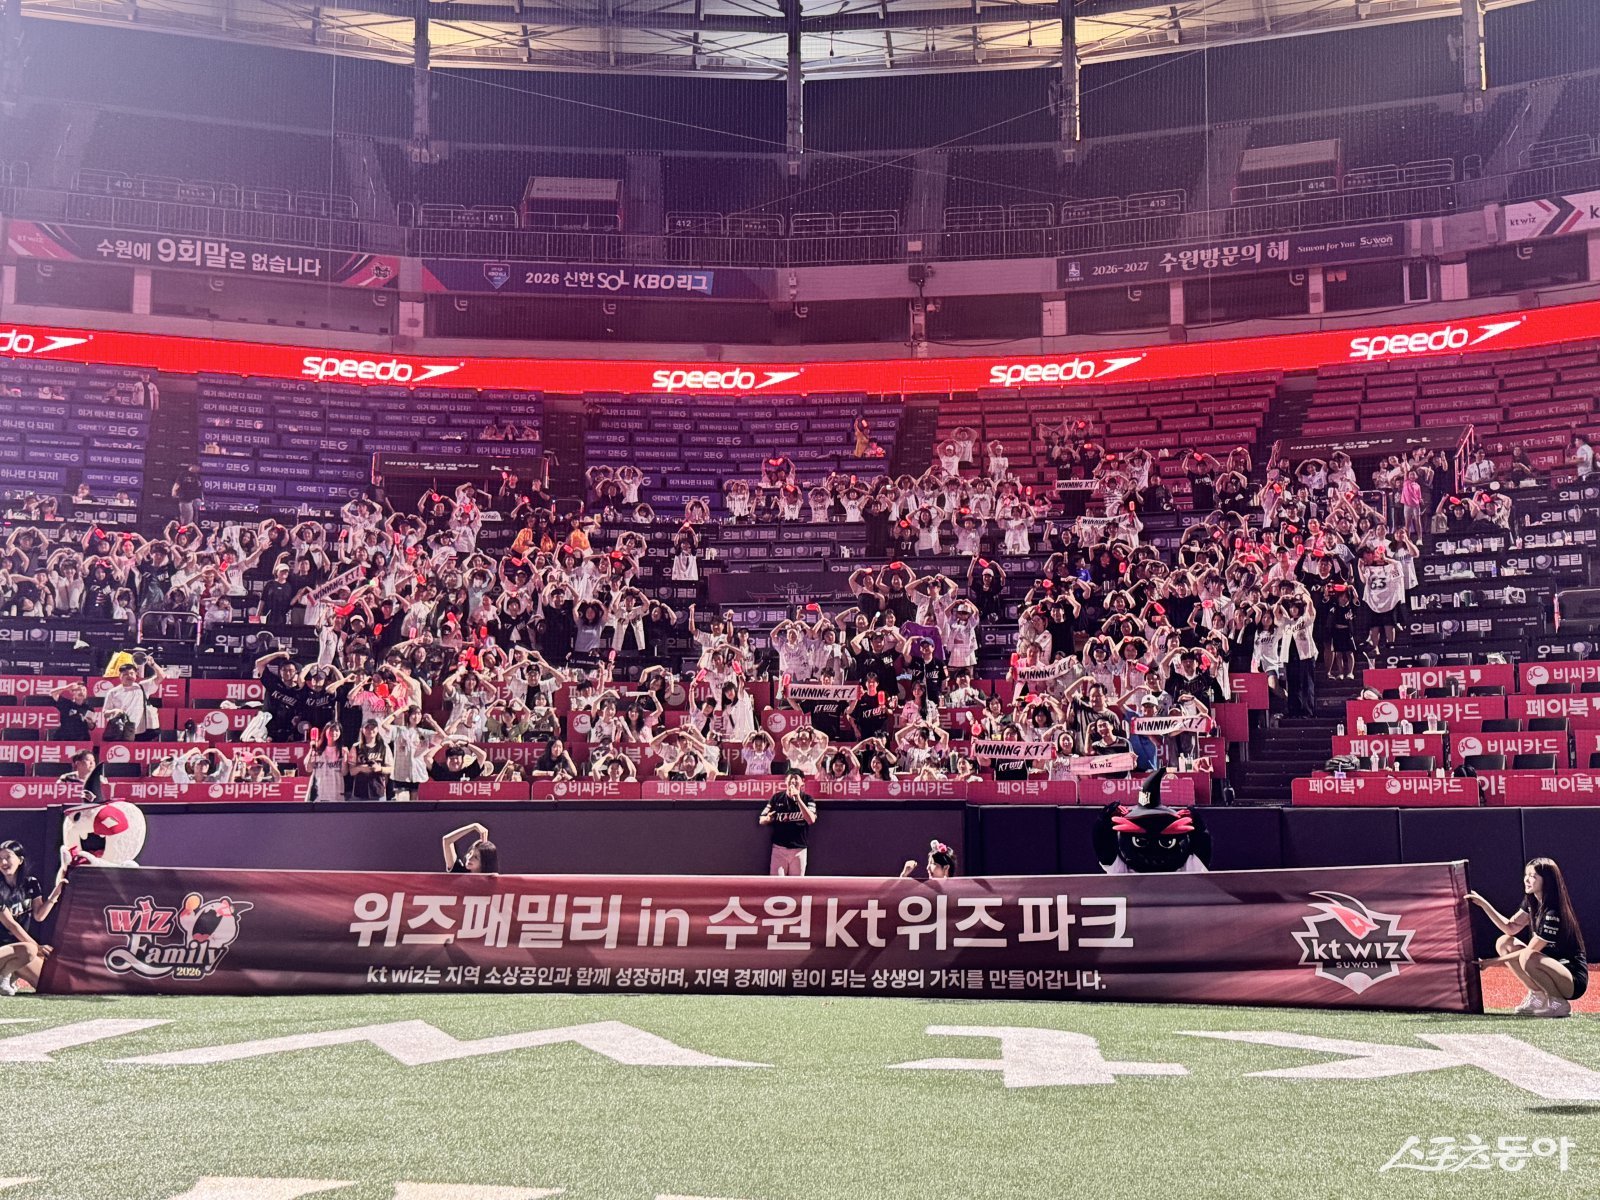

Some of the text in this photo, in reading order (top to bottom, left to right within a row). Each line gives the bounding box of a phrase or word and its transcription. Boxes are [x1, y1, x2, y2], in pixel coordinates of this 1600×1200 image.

[675, 219, 692, 227] 412
[97, 238, 322, 277] 수원에 9회말은 없습니다
[1092, 261, 1150, 276] 2026-2027
[1159, 242, 1262, 273] 수원방문의
[1267, 239, 1289, 261] 해
[525, 272, 559, 285] 2026
[563, 271, 595, 288] 신한
[1350, 326, 1469, 361] speedo
[302, 356, 412, 381] speedo
[990, 358, 1095, 388] speedo
[652, 366, 755, 393] speedo
[1057, 481, 1083, 489] WINNING
[1019, 669, 1056, 680] WINNING
[790, 686, 855, 699] WINNING KT!
[1404, 701, 1483, 722] 비씨카드
[1526, 698, 1590, 718] 페이북
[0, 711, 59, 729] 비씨카드
[1136, 719, 1177, 732] WINNING
[0, 745, 61, 763] 페이북
[975, 743, 1049, 756] WINNING KT!
[1487, 737, 1560, 755] 비씨카드
[135, 745, 185, 765] 비씨카
[1089, 758, 1112, 770] kt wiz
[27, 783, 84, 799] 비씨카드
[131, 783, 179, 799] 페이북
[224, 783, 281, 799] 비씨카드
[449, 782, 492, 797] 페이북
[568, 782, 620, 797] 비씨카드
[657, 782, 698, 797] 페이북
[819, 781, 862, 797] 페이북
[903, 781, 954, 797] 비씨카드
[997, 781, 1039, 797] 페이북
[1308, 778, 1355, 795] 페이북
[1402, 777, 1464, 795] 비씨카드
[1540, 777, 1593, 793] 페이북
[107, 897, 174, 934] wiz
[349, 891, 1134, 952] 위즈패밀리 in 수원 kt 위즈 파크
[106, 932, 228, 975] Family
[1311, 937, 1342, 961] kt
[176, 966, 202, 978] 2026
[366, 965, 1107, 991] kt wiz는 지역 소상공인과 함께 성장하며, 지역 경제에 힘이 되는 상생의 가치를 만들어갑니다.
